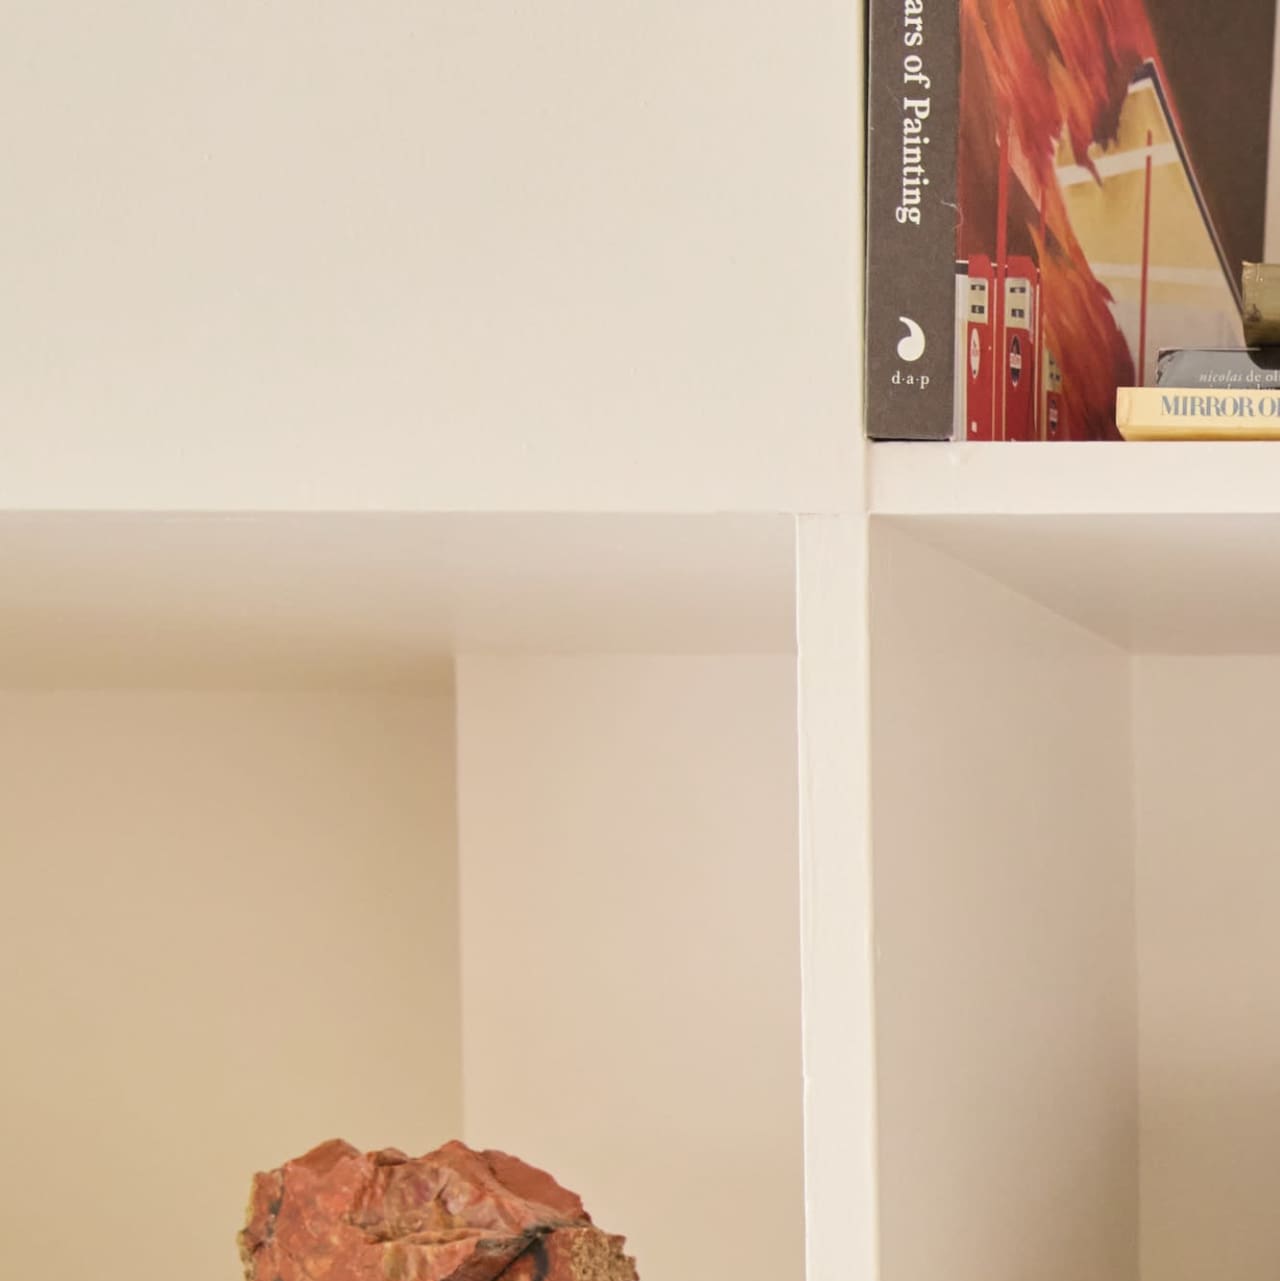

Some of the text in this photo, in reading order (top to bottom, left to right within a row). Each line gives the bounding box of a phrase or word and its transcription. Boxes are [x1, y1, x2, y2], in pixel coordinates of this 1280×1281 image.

[904, 55, 930, 89] of
[896, 97, 930, 225] Painting
[1199, 370, 1242, 382] nicolas
[1246, 370, 1261, 382] de
[1160, 395, 1255, 417] MIRROR
